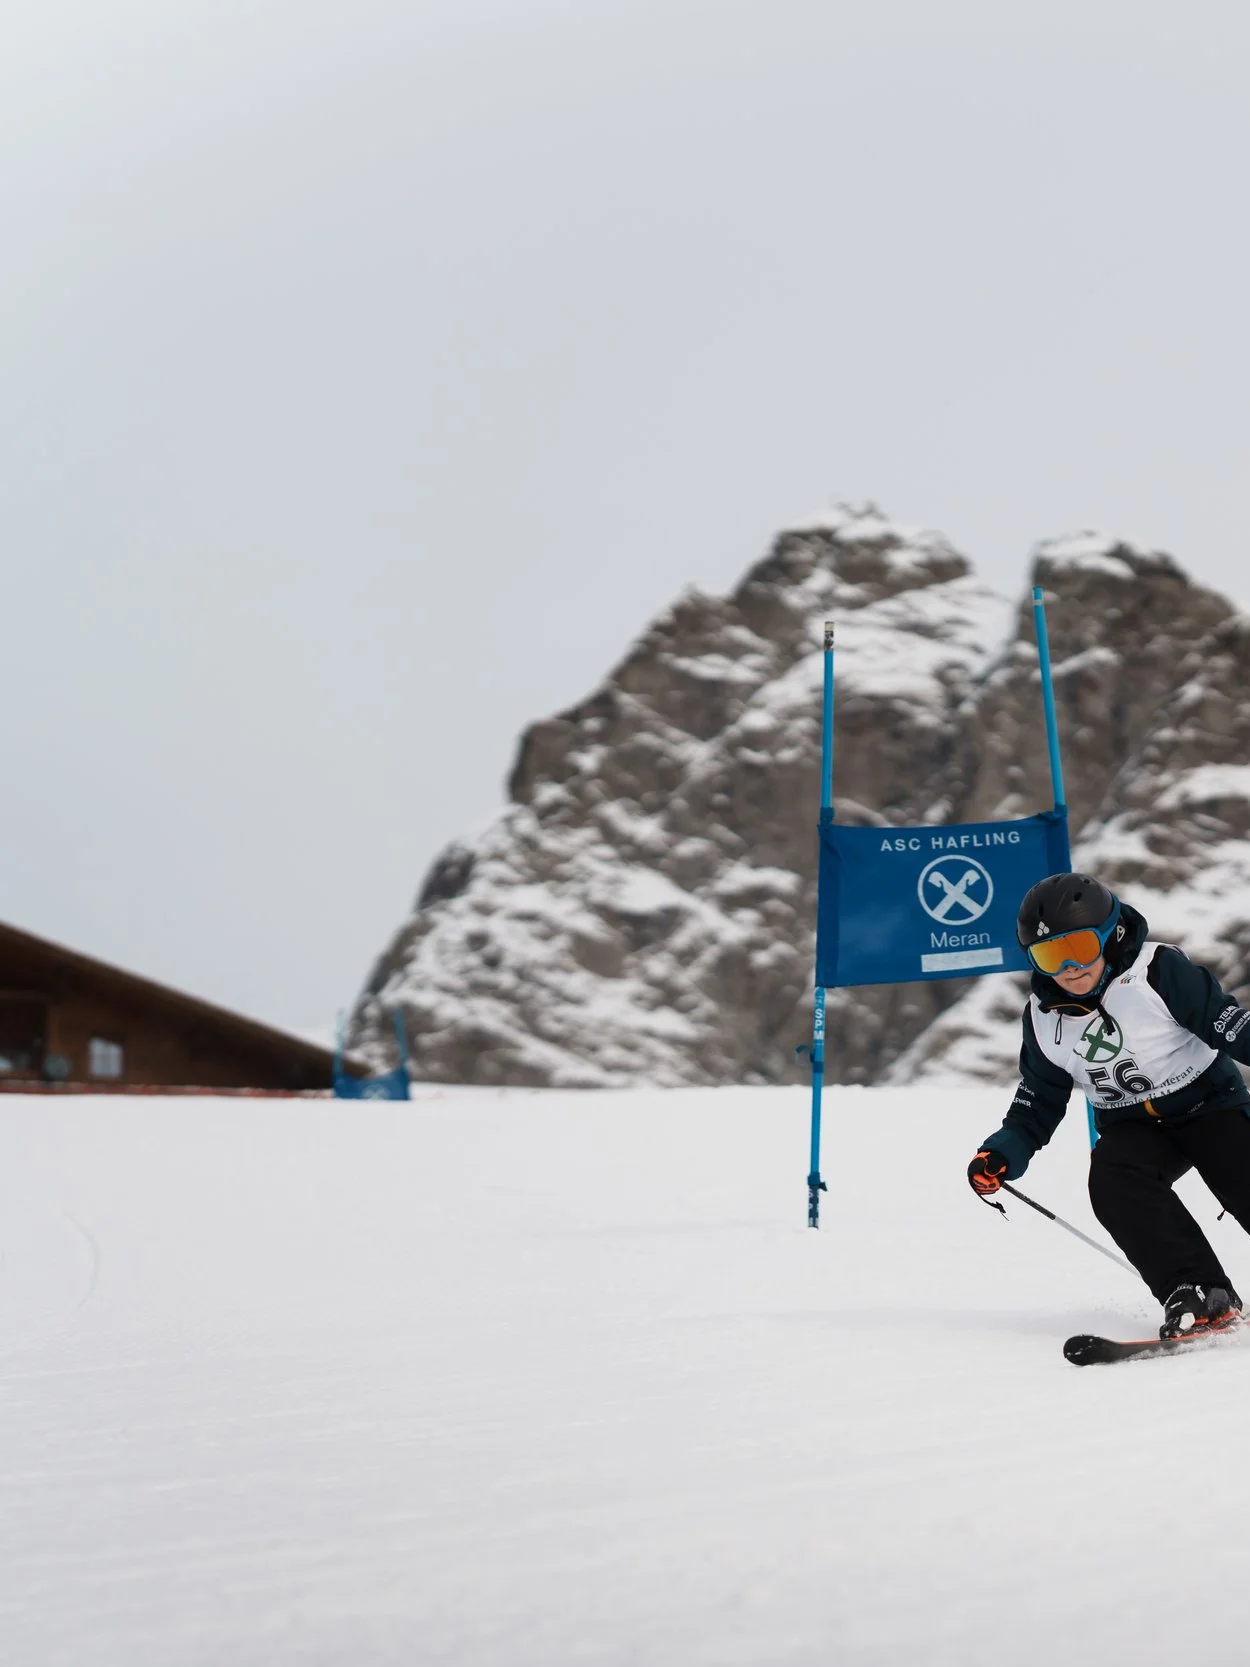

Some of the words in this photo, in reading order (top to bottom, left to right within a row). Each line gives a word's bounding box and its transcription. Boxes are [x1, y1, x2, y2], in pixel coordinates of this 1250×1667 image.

[880, 838, 921, 852] ASC
[931, 831, 1021, 850] HAFLING
[930, 931, 991, 948] Meran
[1085, 1058, 1156, 1103] 56
